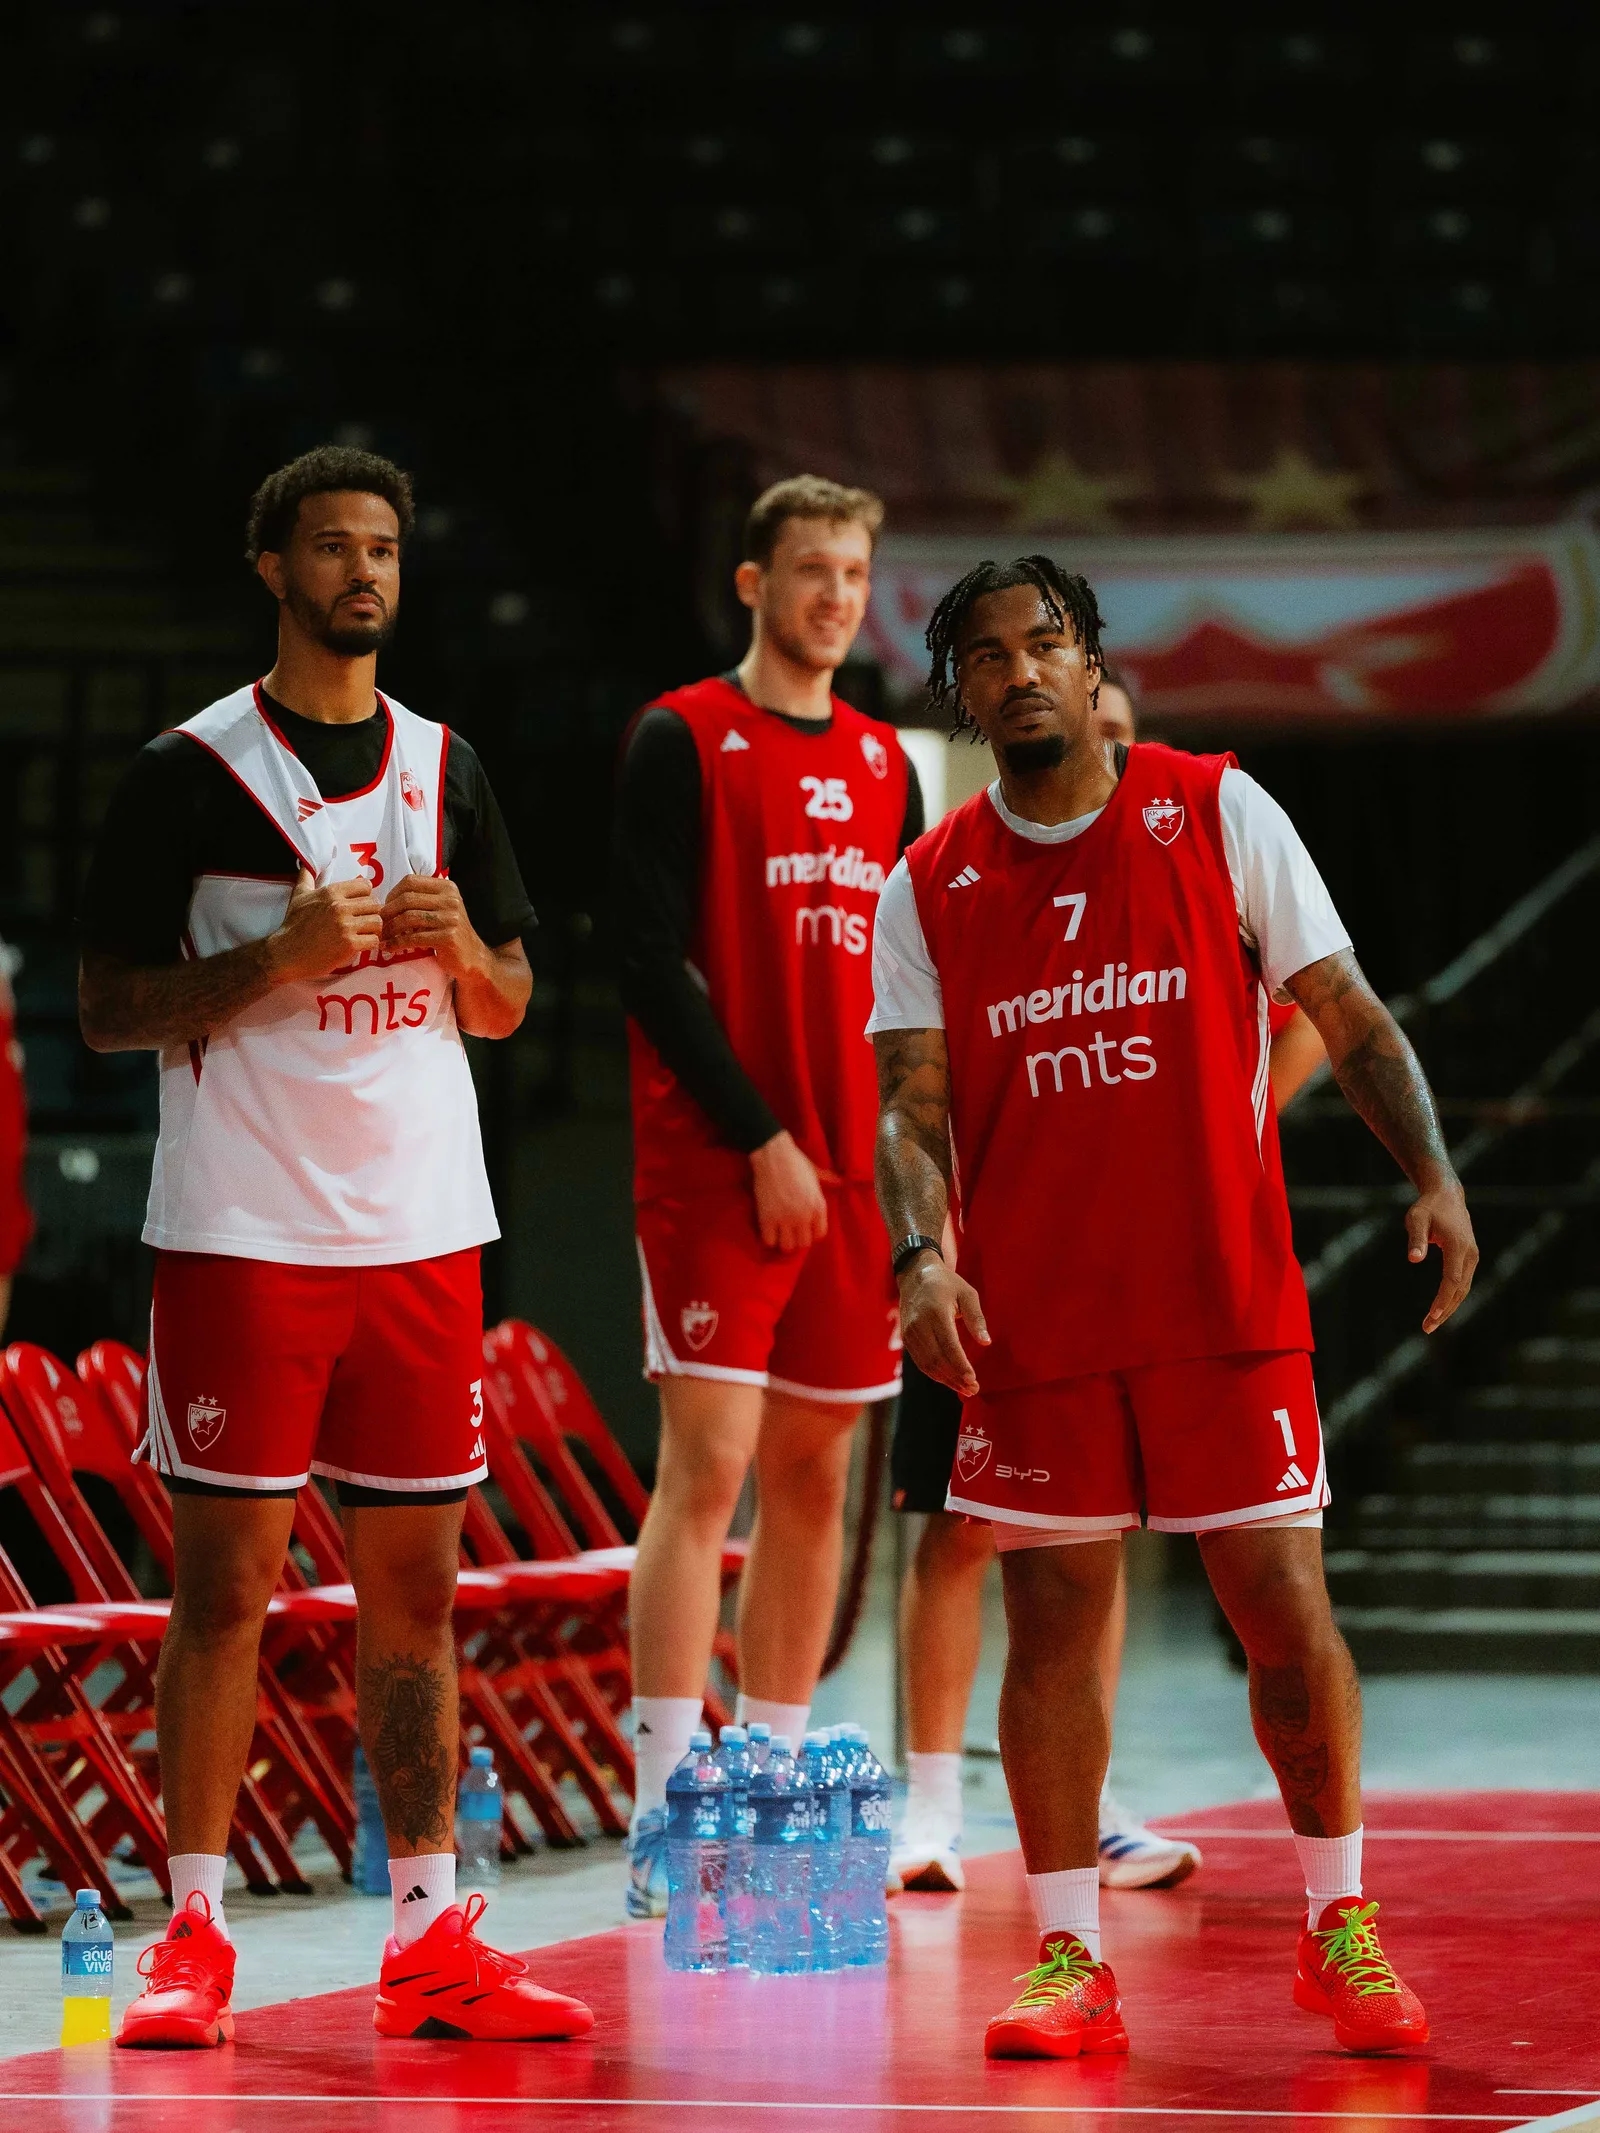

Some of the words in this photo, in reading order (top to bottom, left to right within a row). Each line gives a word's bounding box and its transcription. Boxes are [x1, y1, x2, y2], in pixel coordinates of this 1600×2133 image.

[799, 776, 854, 822] 25
[349, 842, 384, 889] 3
[765, 844, 886, 894] meridia
[1053, 892, 1087, 942] 7
[317, 981, 431, 1035] mts
[986, 962, 1187, 1038] meridian
[1026, 1031, 1157, 1098] mts
[469, 1378, 484, 1428] 3
[1272, 1408, 1297, 1458] 1
[995, 1464, 1051, 1483] BYD
[82, 1948, 113, 1962] aqua
[84, 1961, 112, 1973] viva
